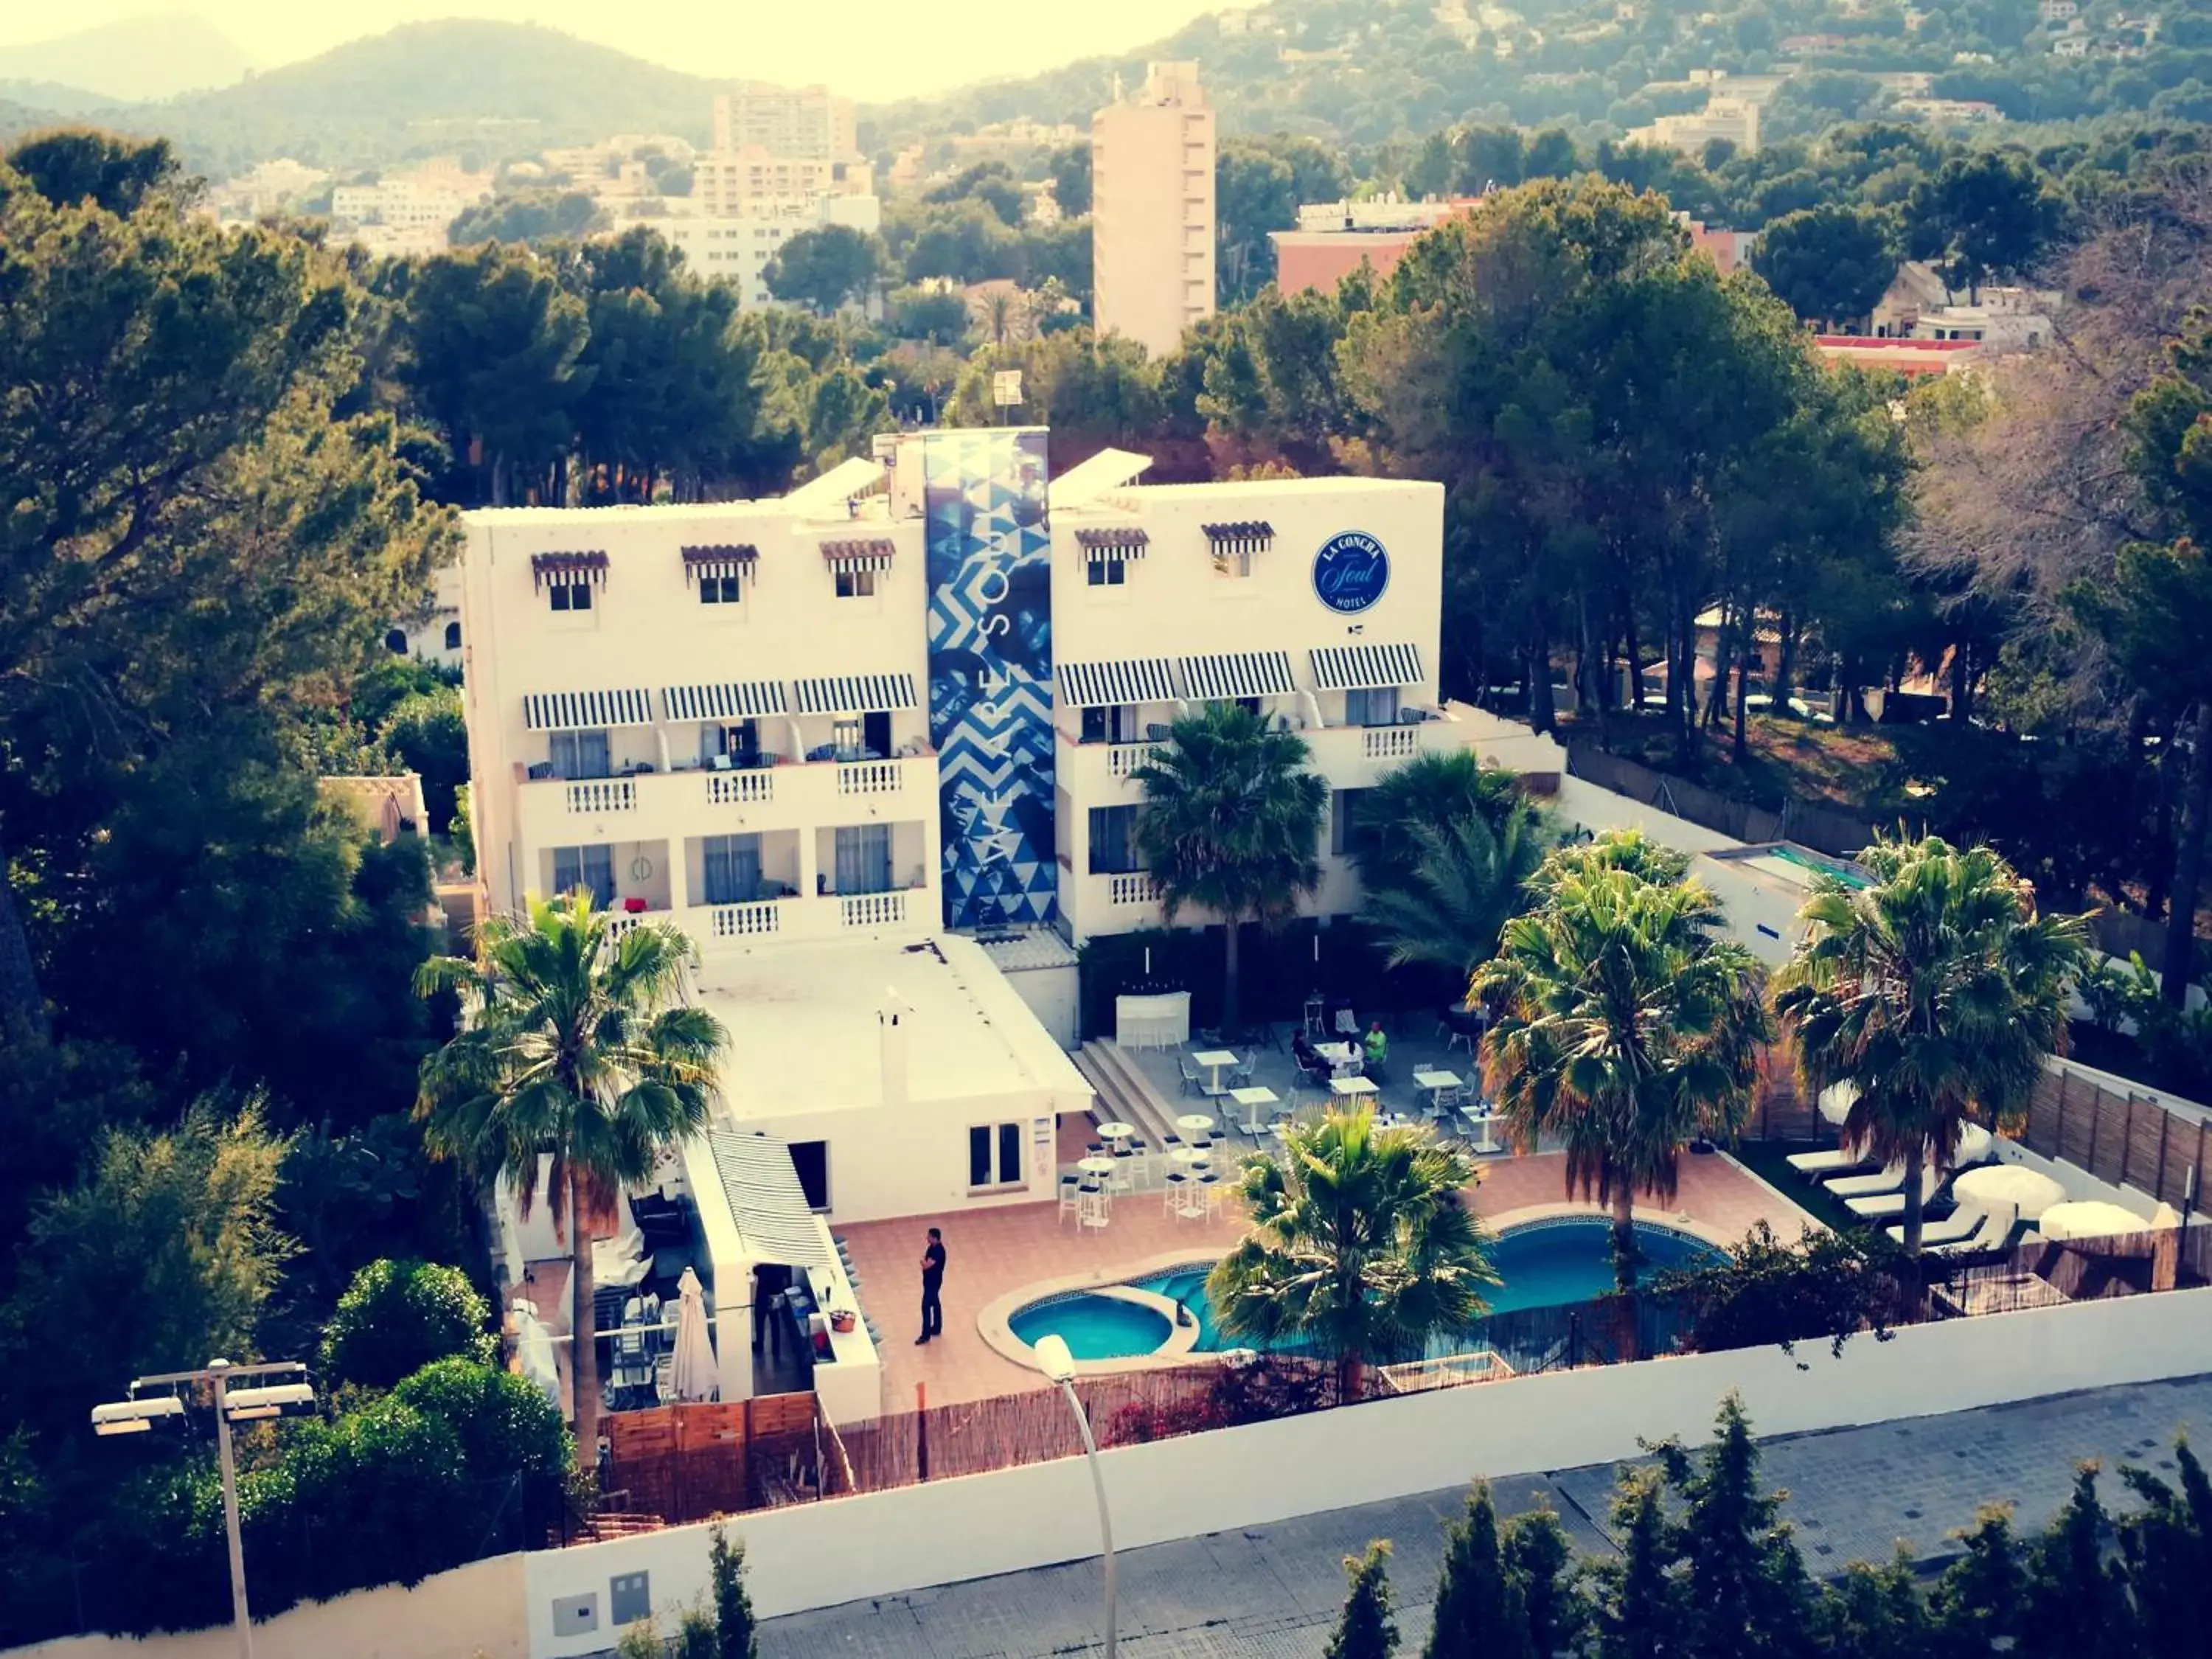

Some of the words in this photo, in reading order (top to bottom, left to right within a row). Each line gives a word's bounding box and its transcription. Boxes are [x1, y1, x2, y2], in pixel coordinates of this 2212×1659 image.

[1322, 546, 1339, 562] LA
[1338, 536, 1380, 560] CONCHA
[1321, 559, 1379, 594] Soul
[1335, 596, 1366, 608] HOTEL
[978, 669, 1012, 758] ARE
[981, 790, 1014, 864] WE
